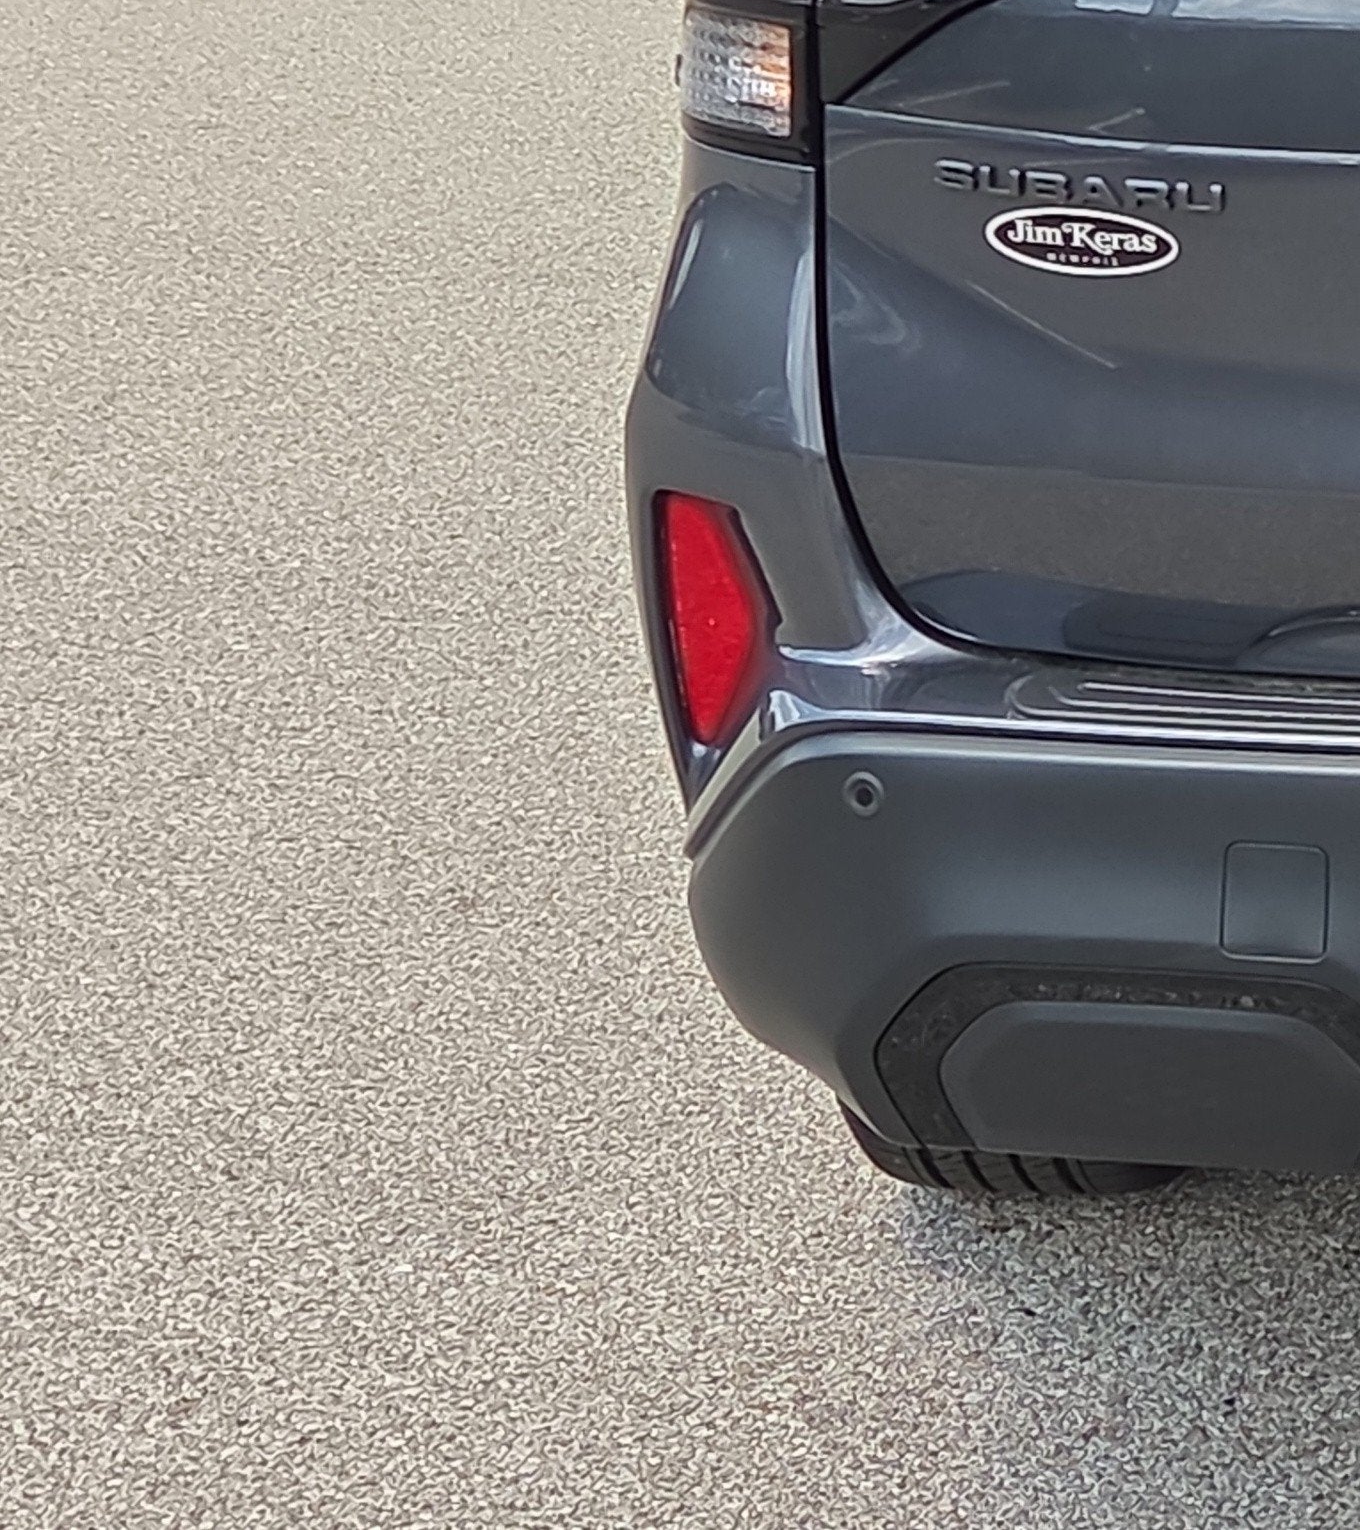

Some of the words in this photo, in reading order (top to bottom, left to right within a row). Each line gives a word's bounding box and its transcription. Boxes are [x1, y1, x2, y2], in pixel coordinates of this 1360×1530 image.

[933, 157, 1228, 214] SUBARU
[1006, 218, 1062, 247] Jim
[1061, 221, 1159, 255] Keras
